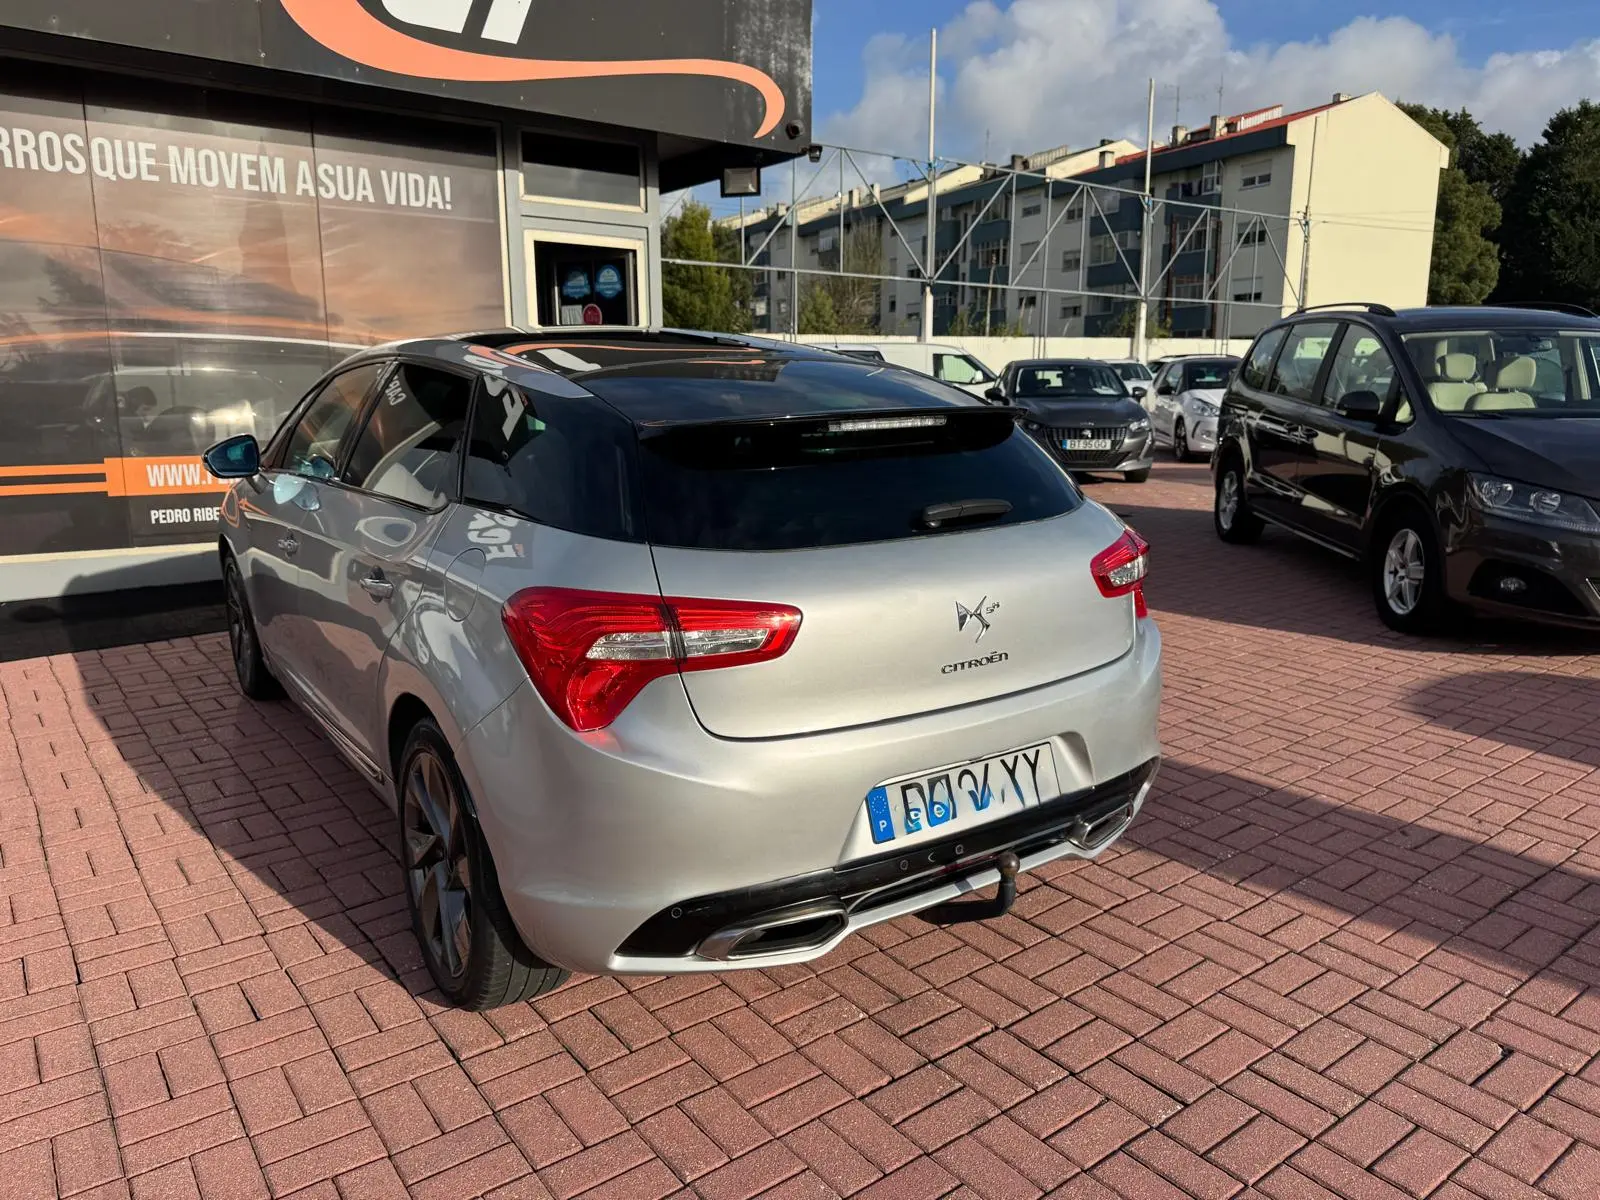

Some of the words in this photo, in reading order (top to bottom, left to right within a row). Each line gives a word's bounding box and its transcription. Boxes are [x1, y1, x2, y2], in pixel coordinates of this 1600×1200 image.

[91, 137, 160, 183] QUE
[168, 145, 286, 195] MOVEM
[295, 160, 316, 198] A
[315, 165, 375, 204] SUA
[380, 169, 453, 210] VIDA!
[150, 508, 191, 525] PEDRO
[879, 820, 887, 832] P
